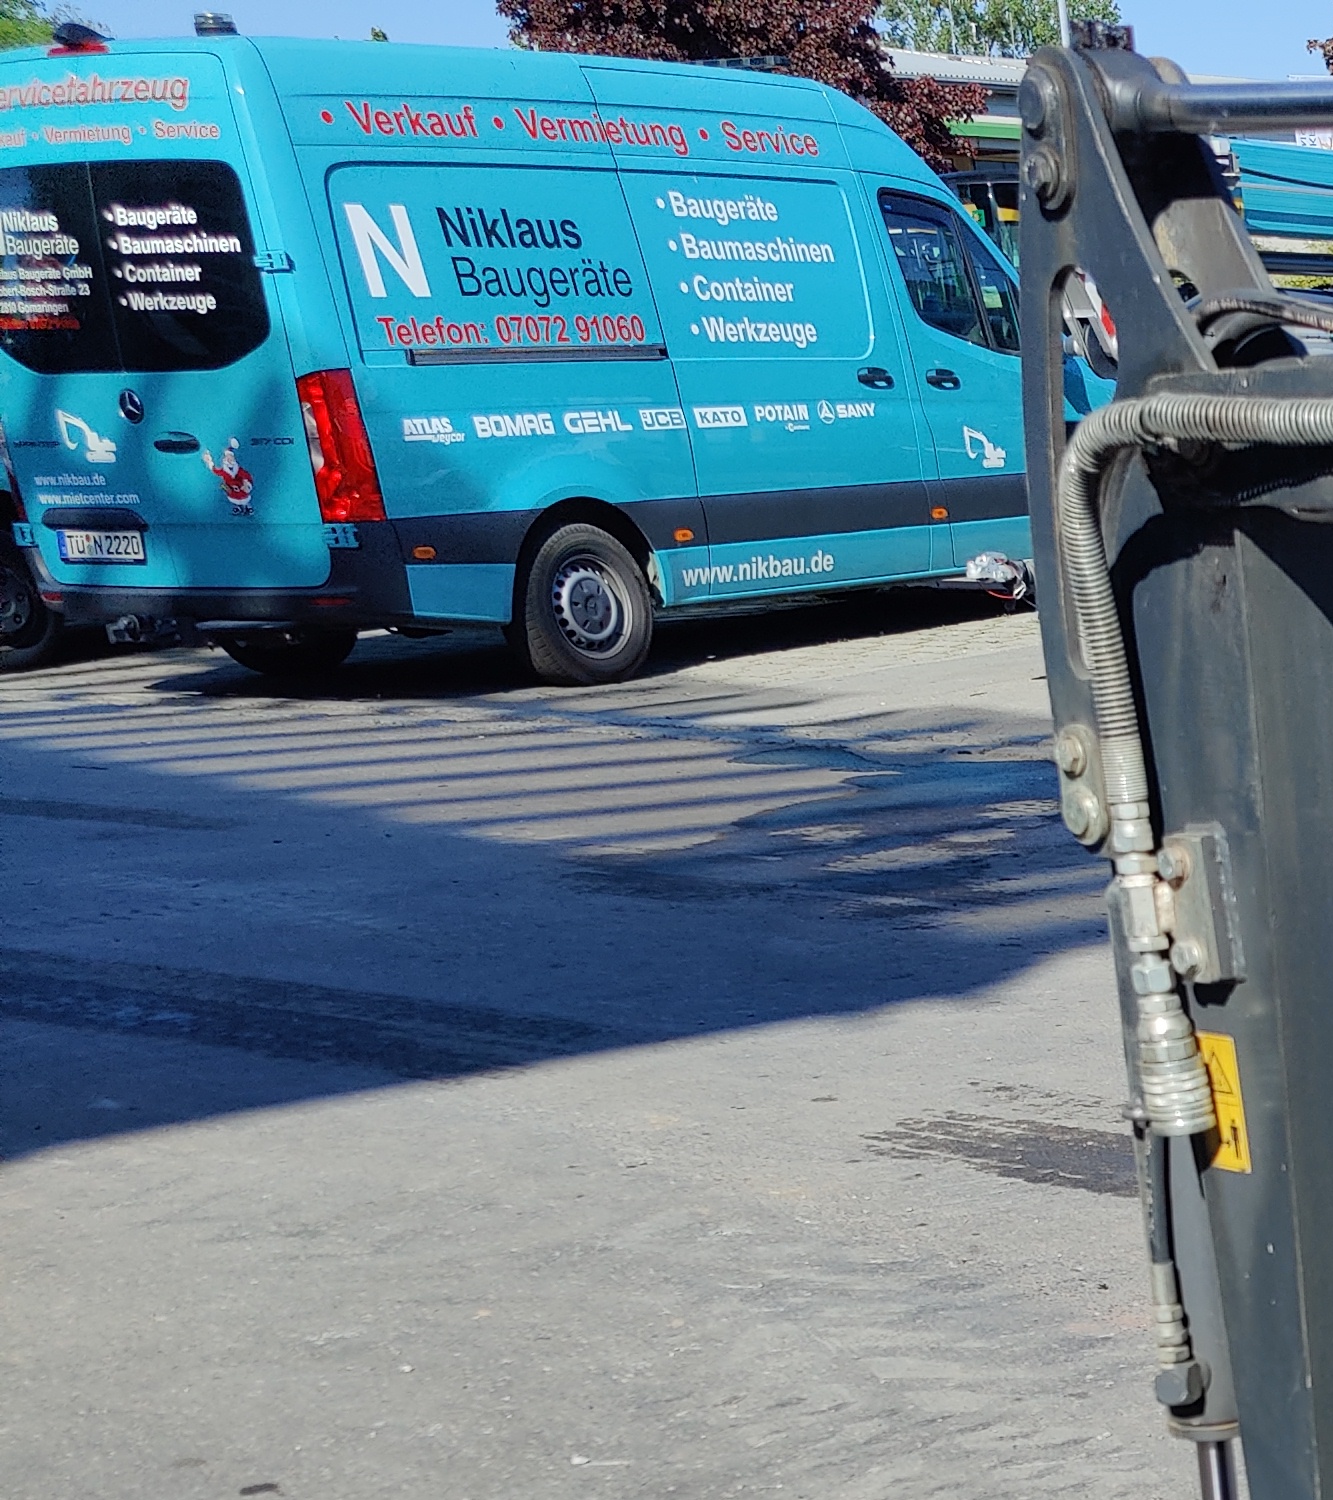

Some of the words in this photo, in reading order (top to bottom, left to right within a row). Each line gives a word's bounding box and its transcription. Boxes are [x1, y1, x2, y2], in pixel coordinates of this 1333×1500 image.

[44, 125, 135, 145] Vermietung
[153, 120, 220, 139] Service
[347, 102, 479, 139] Verkauf
[515, 107, 688, 155] Vermietung
[722, 121, 820, 157] Service
[114, 203, 198, 229] Baugeräte
[669, 192, 778, 224] Baugeräte
[1, 210, 59, 233] Niklaus
[436, 207, 582, 250] Niklaus
[6, 233, 80, 259] Baugeräte
[118, 232, 242, 254] Baumaschinen
[344, 204, 431, 298] N
[680, 233, 835, 264] Baumaschinen
[18, 267, 61, 282] Baugeräte
[62, 264, 93, 280] GmbH
[123, 261, 202, 283] Container
[453, 257, 633, 307] Baugeräte
[78, 284, 91, 296] 23
[694, 276, 795, 304] Container
[18, 301, 69, 315] Gomaringen
[128, 291, 216, 314] Werkzeuge
[377, 317, 488, 347] Telefon:
[495, 315, 570, 346] 07072
[578, 315, 645, 345] 91060
[703, 316, 818, 347] Werkzeuge
[563, 410, 633, 434] GEHL
[642, 411, 685, 428] JCB
[700, 409, 742, 425] KATO
[754, 404, 810, 422] POTAIN
[836, 402, 876, 419] SANY
[403, 418, 453, 435] ATLAS
[473, 412, 555, 438] BOMAG
[33, 474, 106, 488] www.nikbau.de
[66, 533, 86, 555] TÜ
[92, 534, 104, 555] N
[105, 533, 141, 557] 2220
[682, 551, 836, 588] www.nikbau.de
